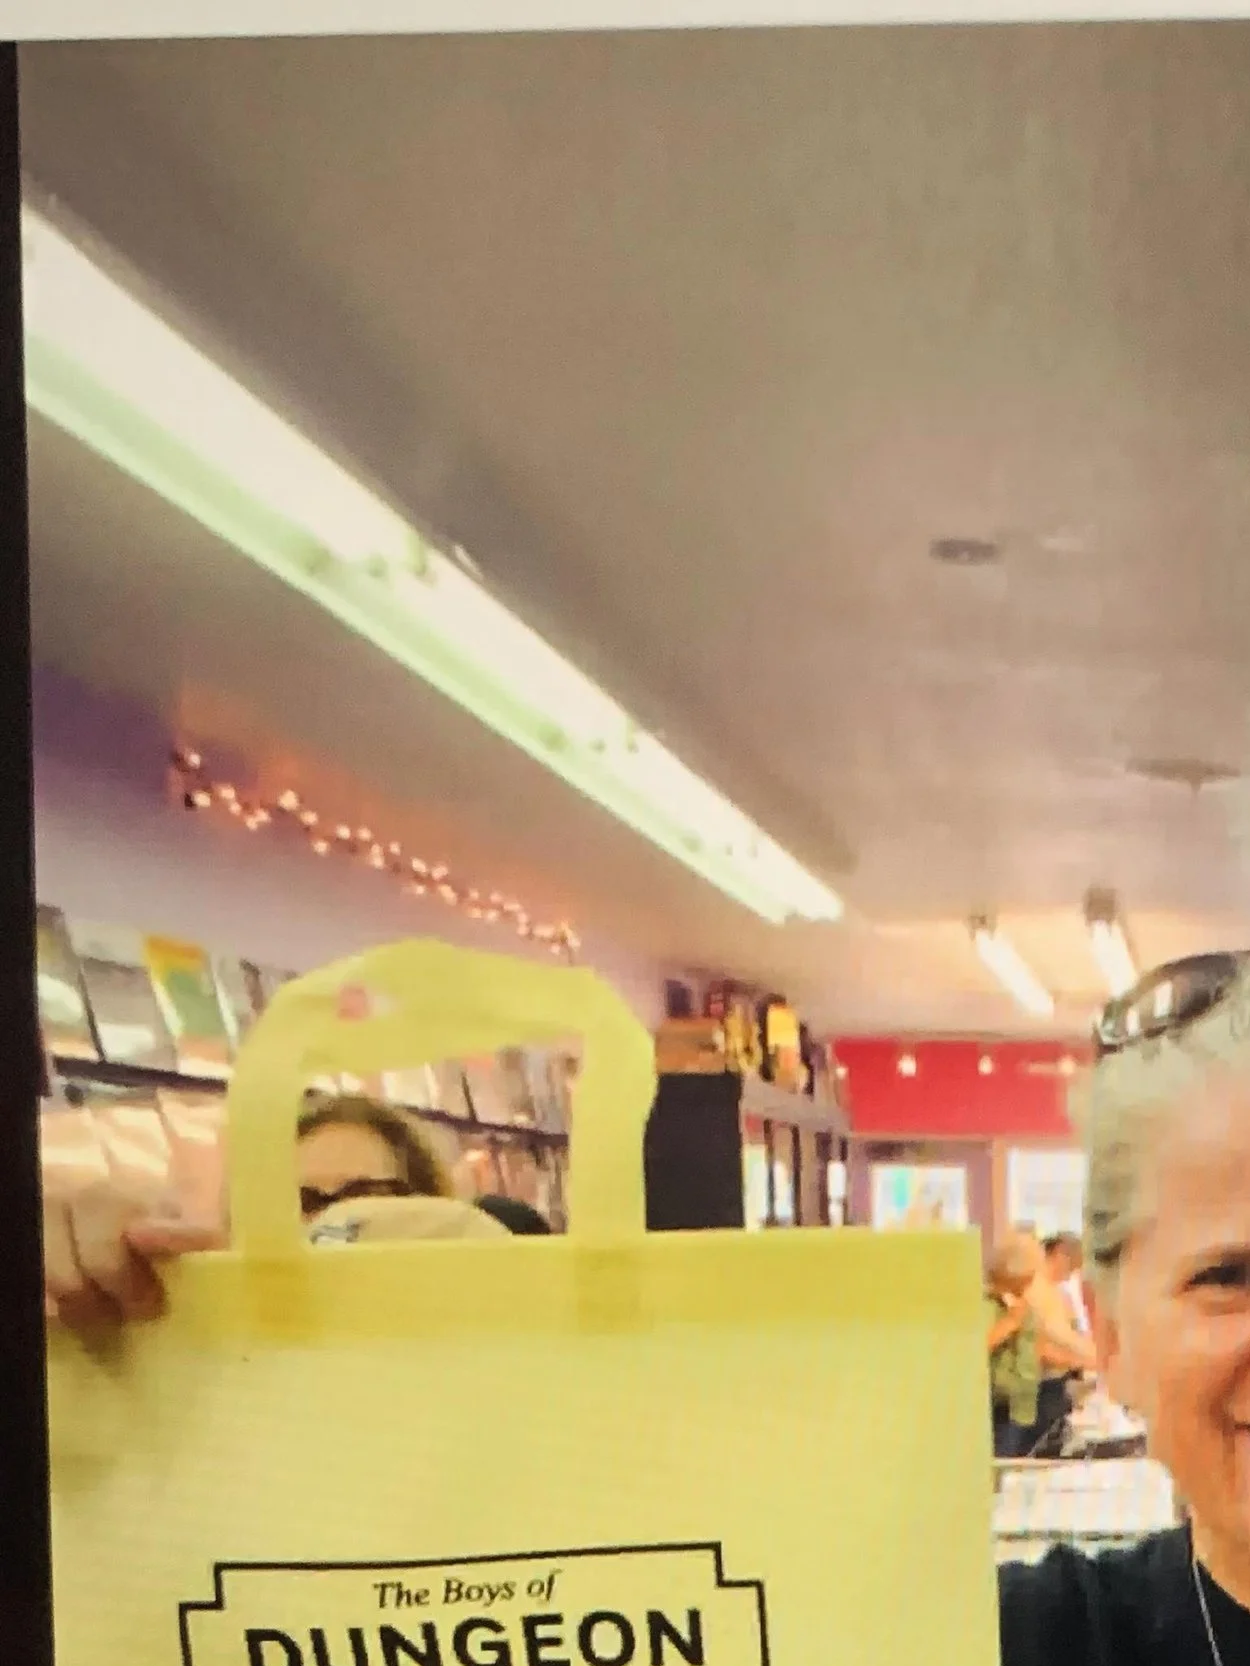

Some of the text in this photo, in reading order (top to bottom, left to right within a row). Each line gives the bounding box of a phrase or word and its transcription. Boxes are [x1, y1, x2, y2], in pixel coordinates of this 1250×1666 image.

[373, 1569, 560, 1609] The Boys of
